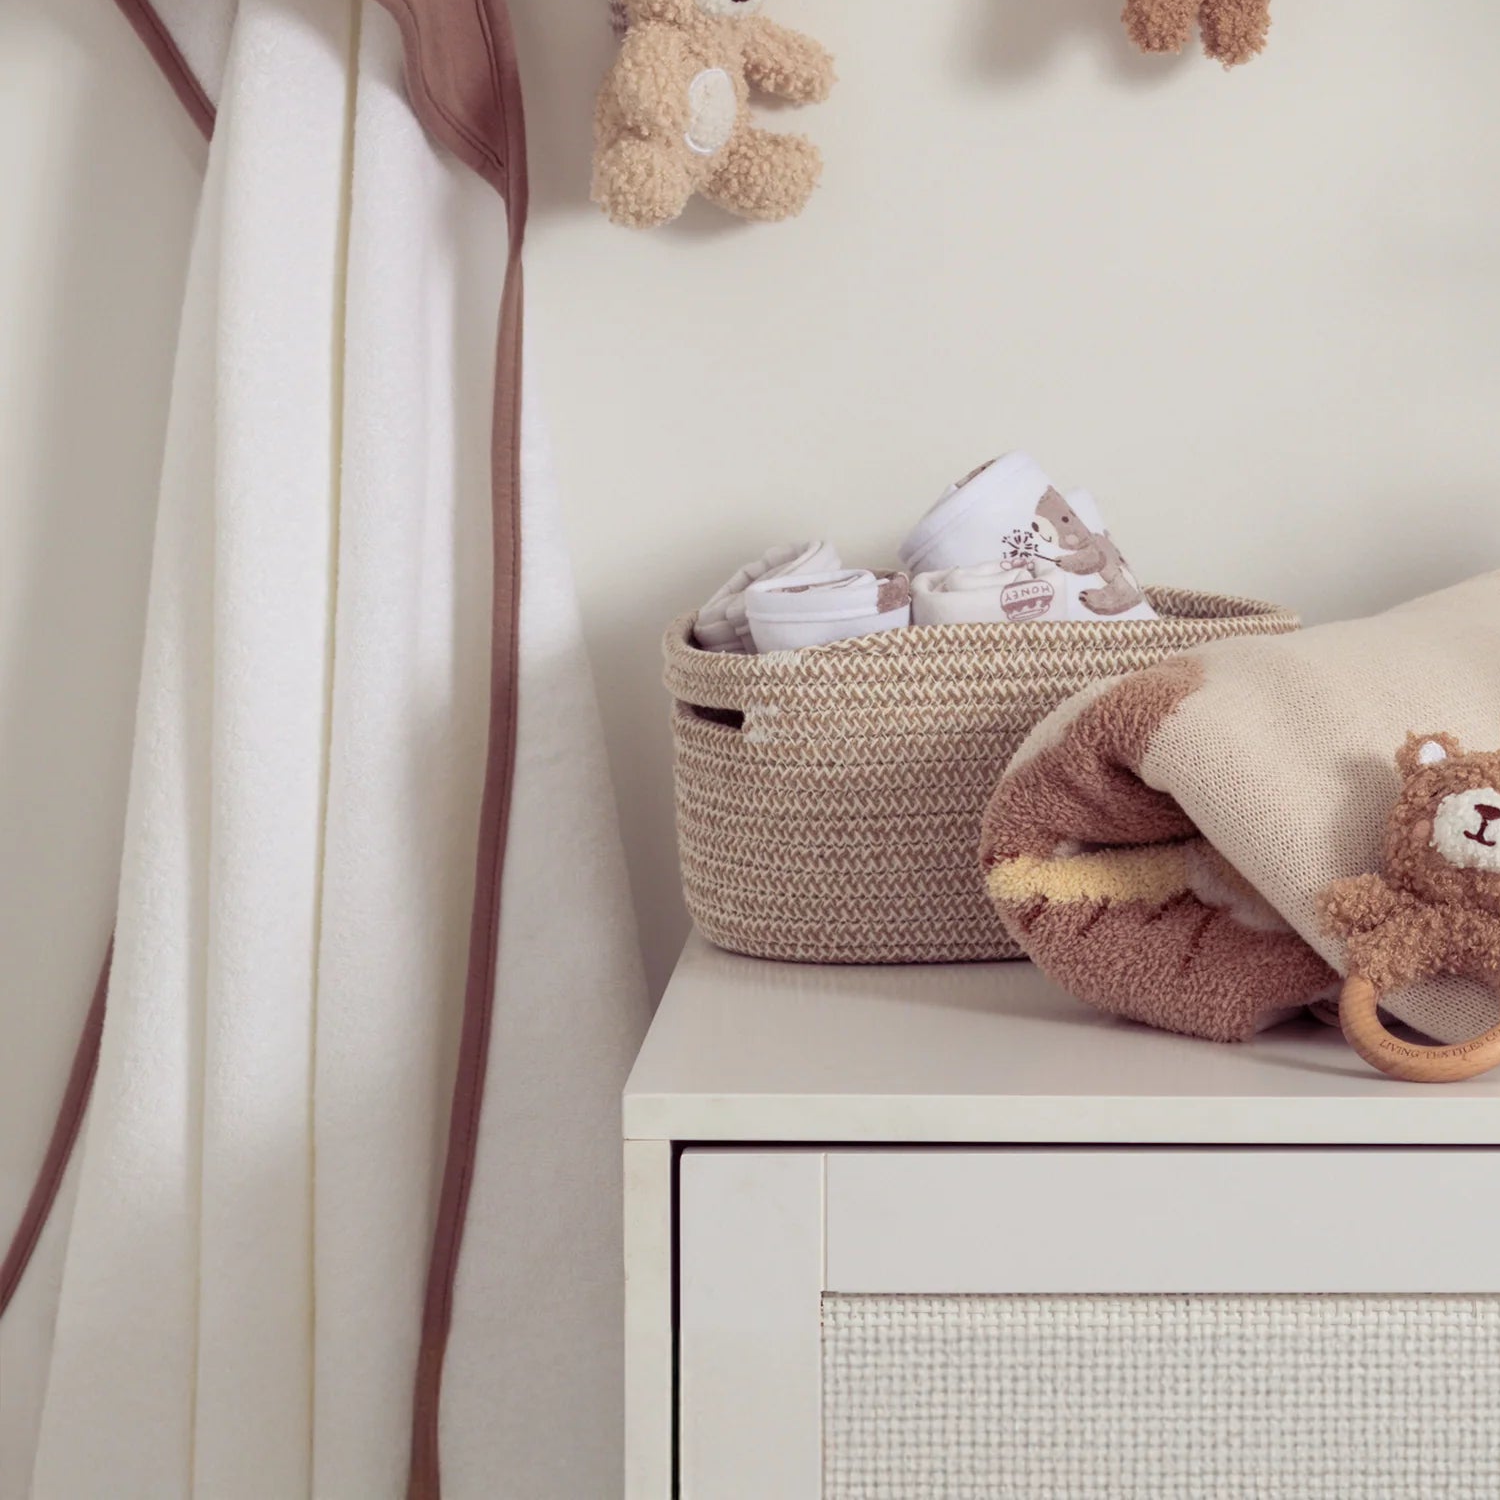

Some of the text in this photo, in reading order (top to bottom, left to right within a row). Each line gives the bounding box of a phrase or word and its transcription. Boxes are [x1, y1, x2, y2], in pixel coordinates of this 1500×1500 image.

[1005, 585, 1050, 602] HONEY
[1379, 1039, 1420, 1058] LIVING
[1422, 1040, 1484, 1060] TEXTILES
